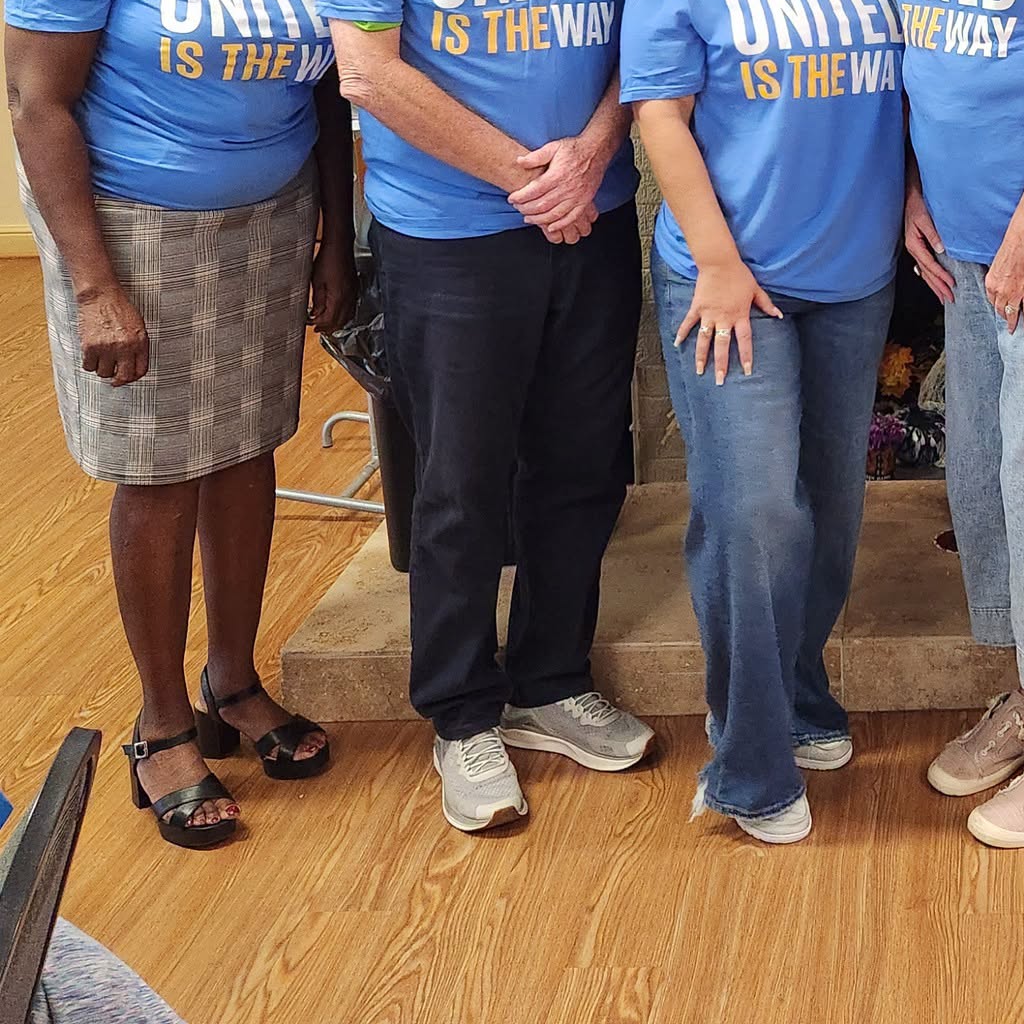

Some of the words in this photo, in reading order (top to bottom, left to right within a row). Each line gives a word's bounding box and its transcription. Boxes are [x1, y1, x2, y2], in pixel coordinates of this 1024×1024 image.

[431, 10, 471, 56] IS
[483, 6, 551, 54] THE
[551, 1, 616, 48] WAY
[902, 4, 946, 51] THE
[944, 9, 1017, 58] WAY
[160, 36, 204, 80] IS
[222, 43, 295, 81] THE
[740, 58, 782, 100] IS
[788, 52, 846, 99] THE
[850, 49, 902, 95] WA
